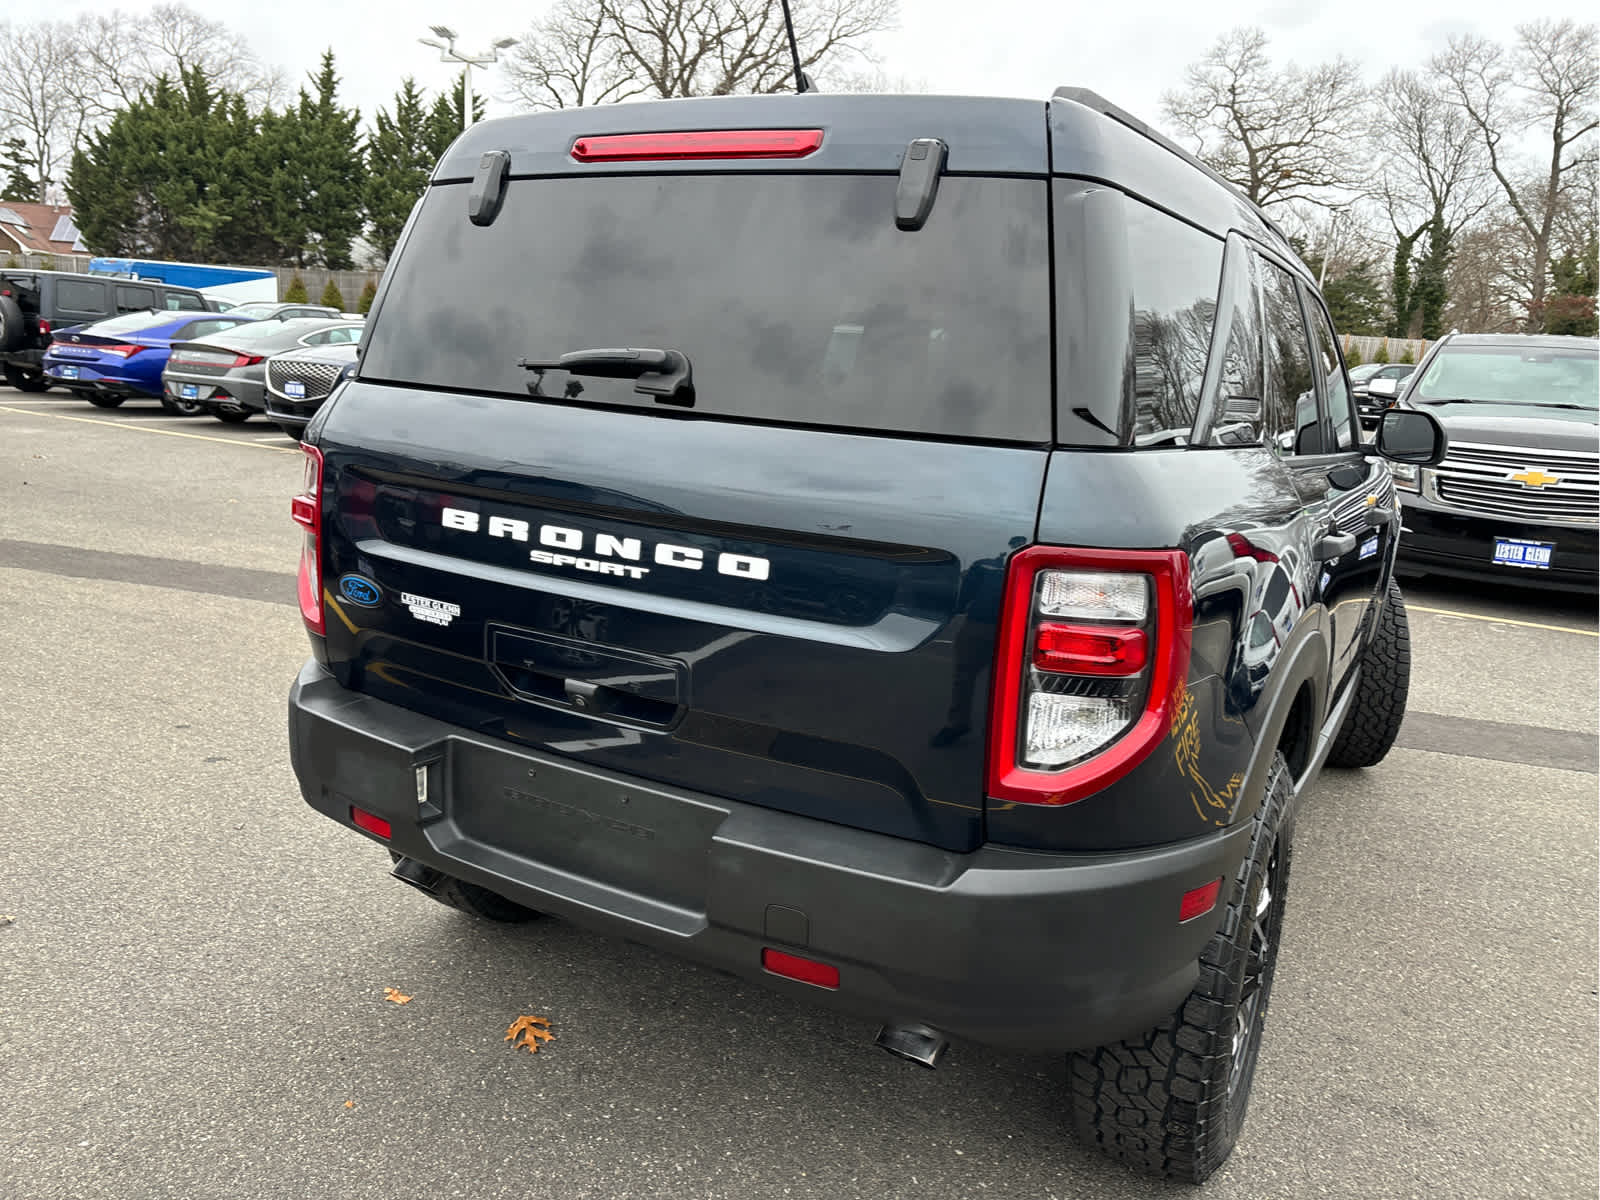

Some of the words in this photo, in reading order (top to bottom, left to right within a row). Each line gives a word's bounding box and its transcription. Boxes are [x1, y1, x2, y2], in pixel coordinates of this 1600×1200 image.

[441, 507, 770, 582] BRONCO
[1495, 543, 1524, 560] LESTER
[1525, 547, 1551, 563] GLENN
[530, 549, 649, 579] SPORT
[346, 580, 371, 601] Ford
[401, 592, 431, 608] LESTER
